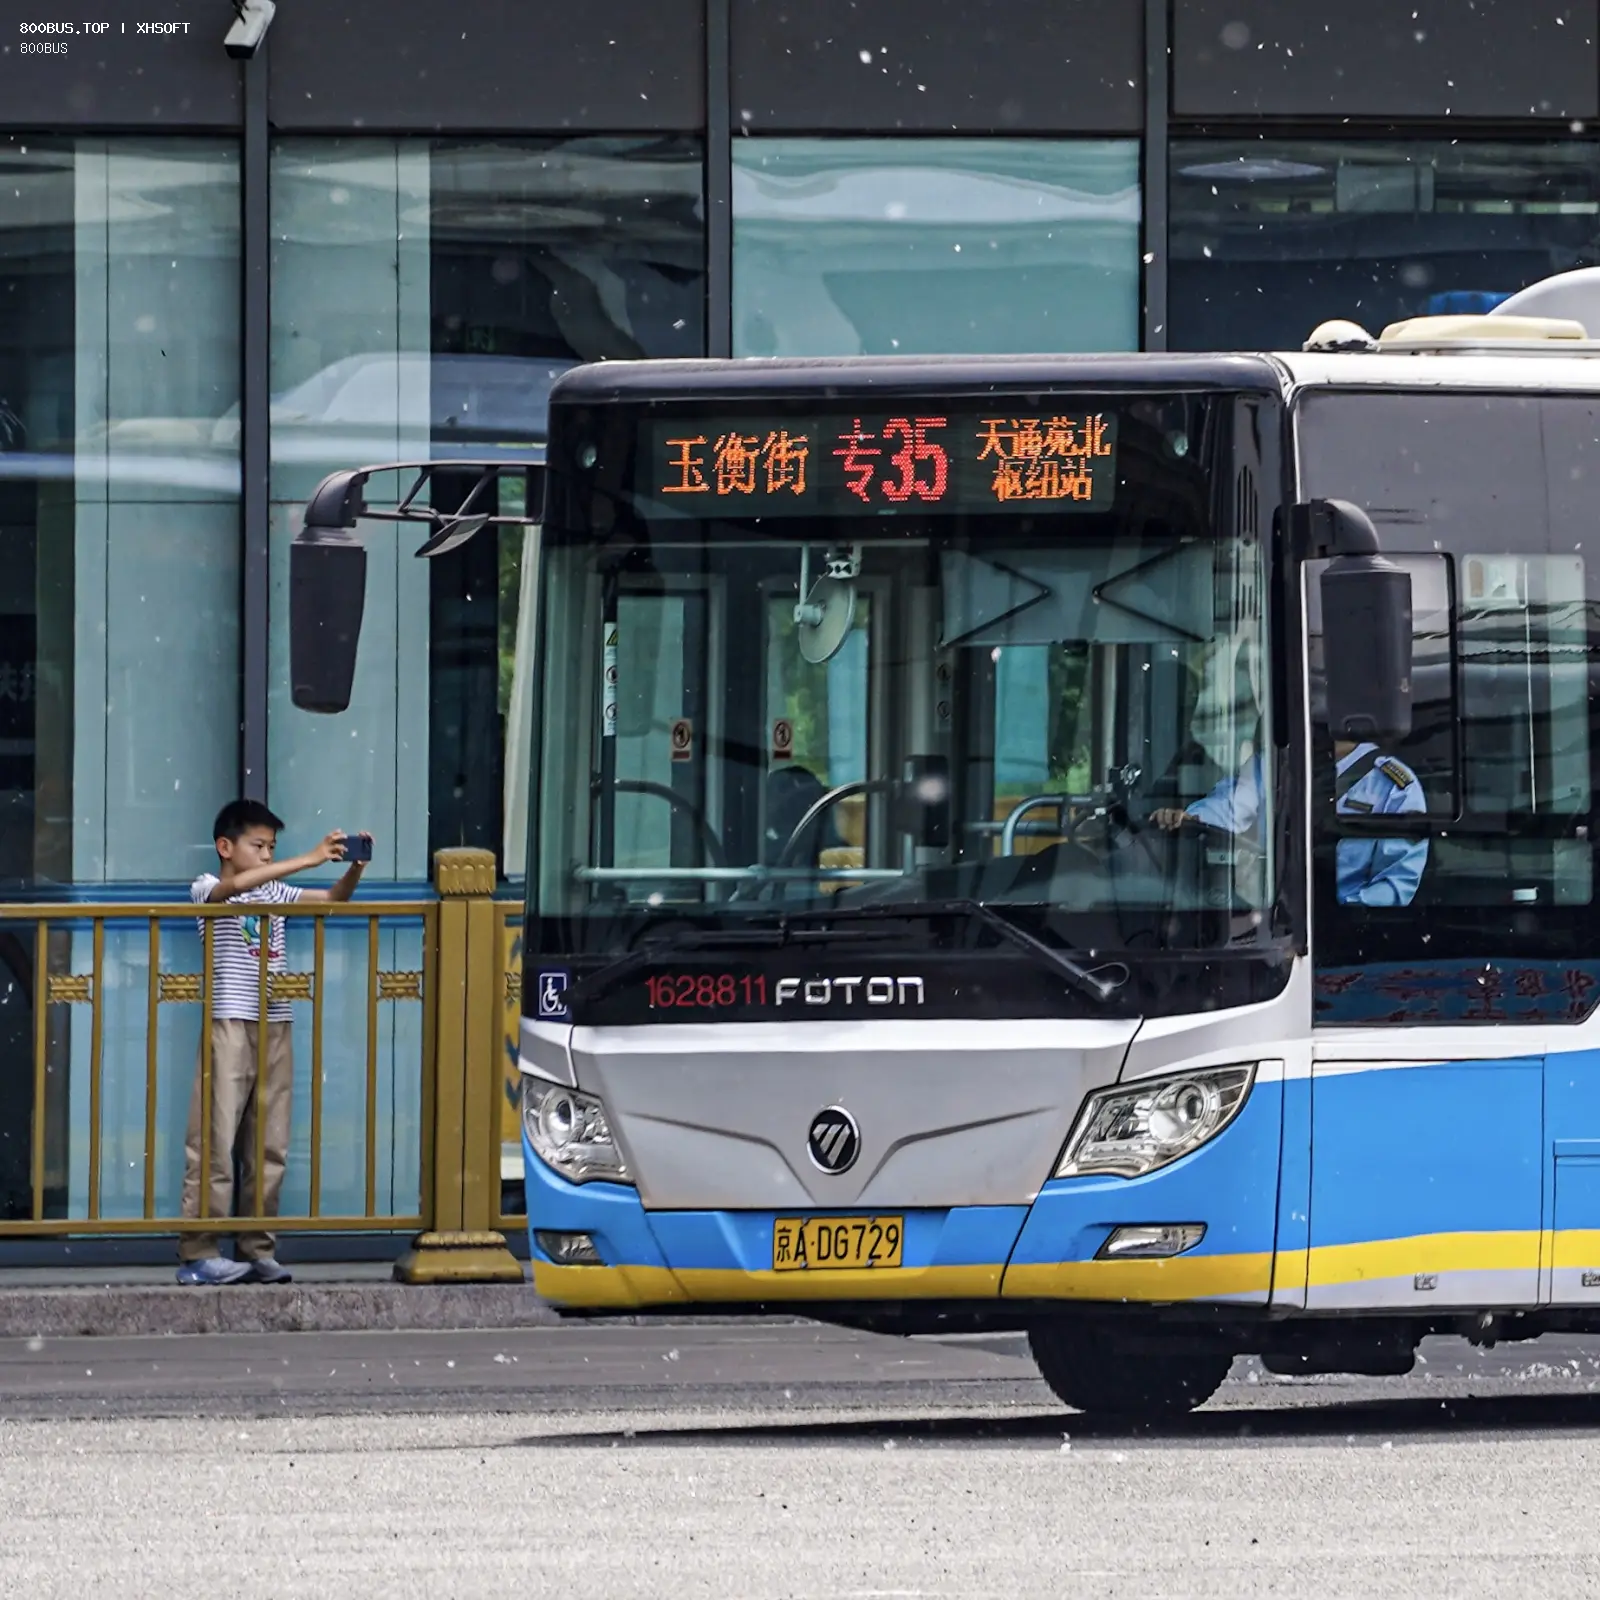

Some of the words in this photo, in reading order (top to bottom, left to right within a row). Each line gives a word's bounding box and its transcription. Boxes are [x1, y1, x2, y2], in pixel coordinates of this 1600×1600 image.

[976, 415, 1111, 459] 天通苑北
[661, 430, 809, 496] 玉衡街
[832, 417, 949, 502] 专35
[991, 458, 1093, 502] 枢纽站
[645, 974, 767, 1008] 1628811
[775, 976, 925, 1006] FOTON
